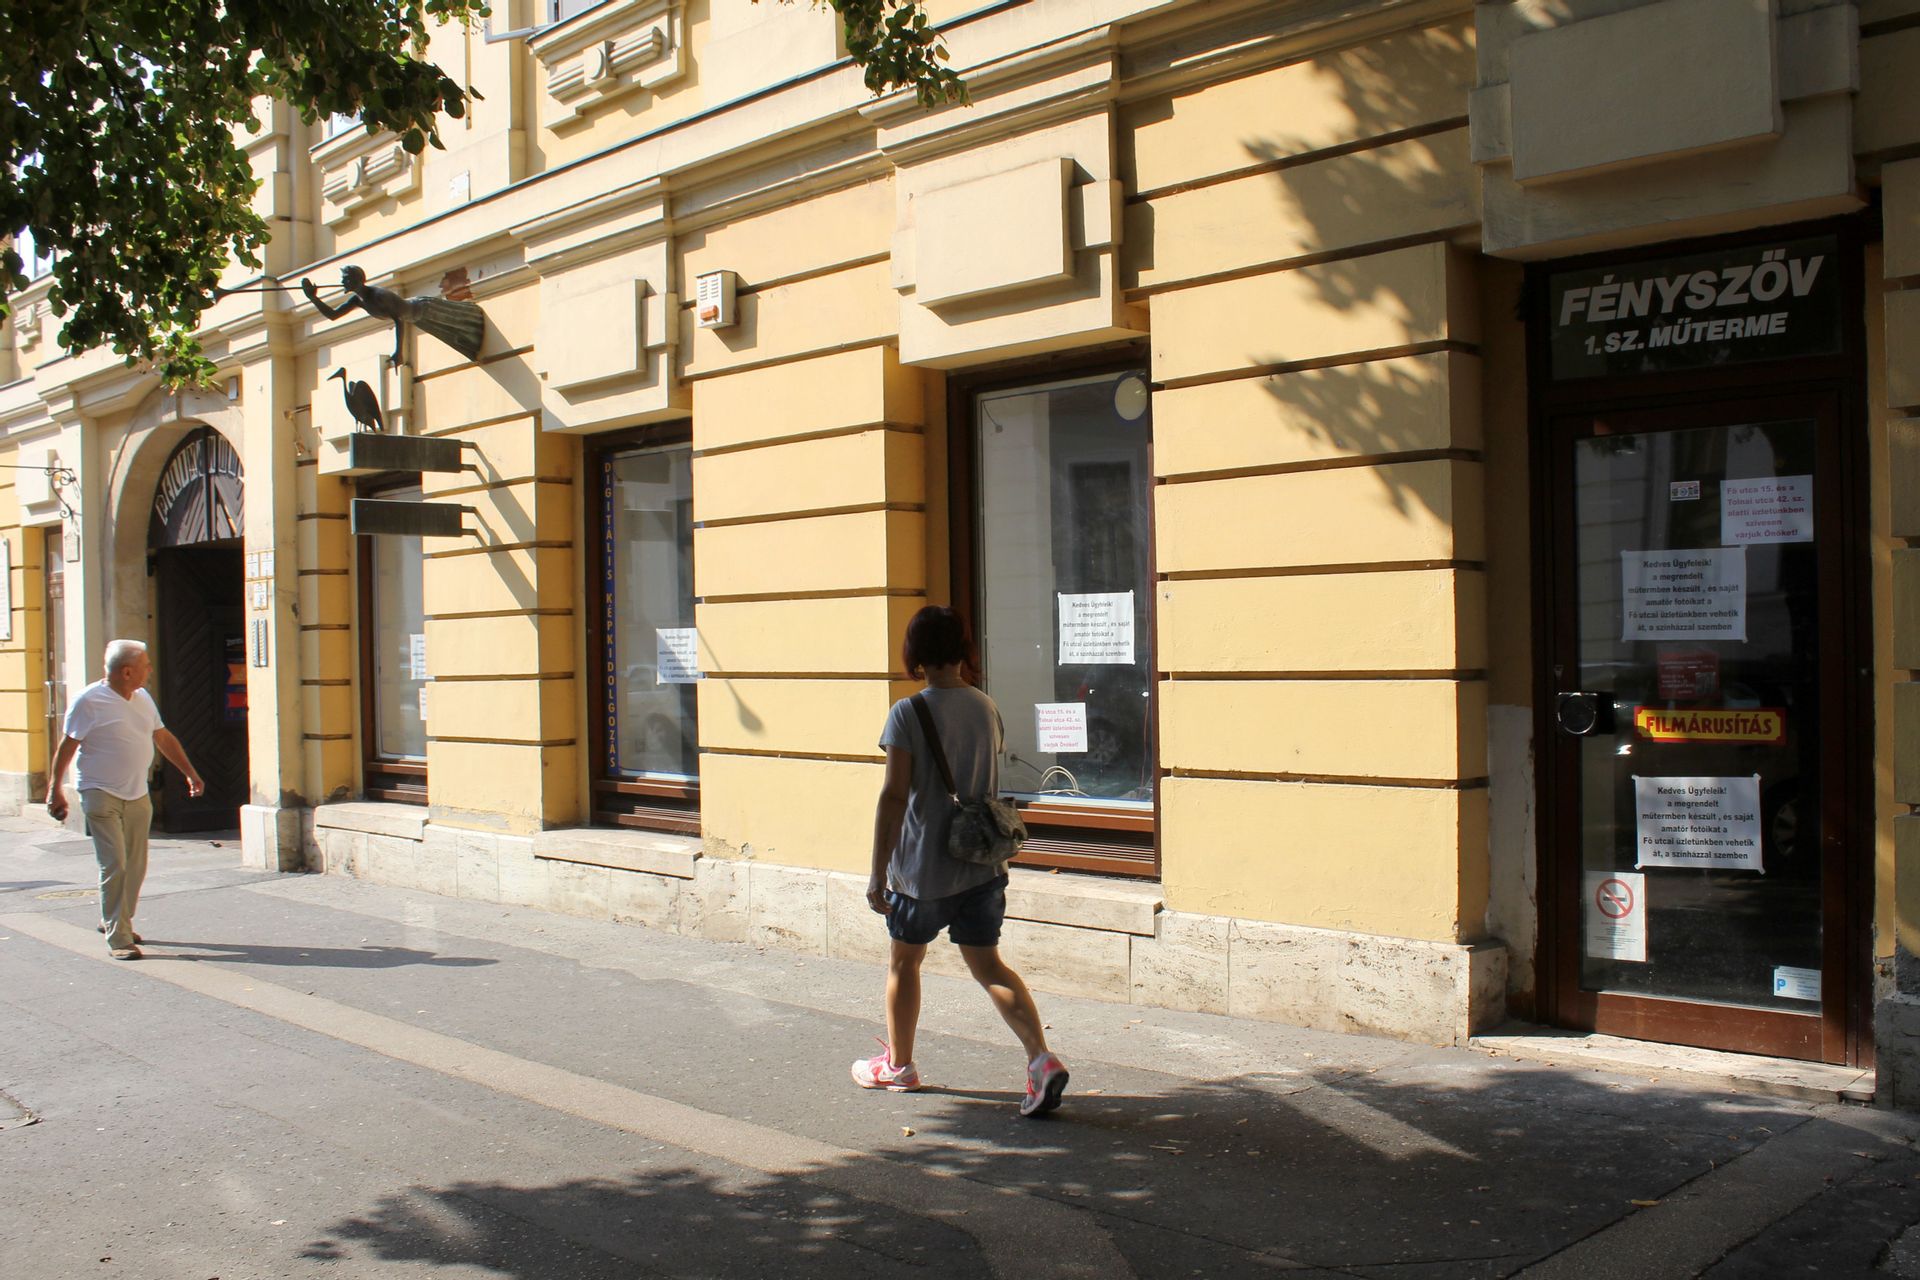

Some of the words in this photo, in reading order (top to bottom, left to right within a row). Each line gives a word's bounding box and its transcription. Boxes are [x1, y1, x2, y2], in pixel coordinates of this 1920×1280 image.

[1559, 248, 1824, 326] FÉNYSZÖV
[1604, 330, 1645, 353] SZ.
[1648, 312, 1789, 348] MŰTERME
[604, 462, 613, 580] DIGITÁLIS
[1660, 573, 1703, 581] megrendelt
[606, 593, 616, 768] KÉPKIDOLGOZÁS
[1646, 712, 1772, 735] FILMÁRUSÍTÁS
